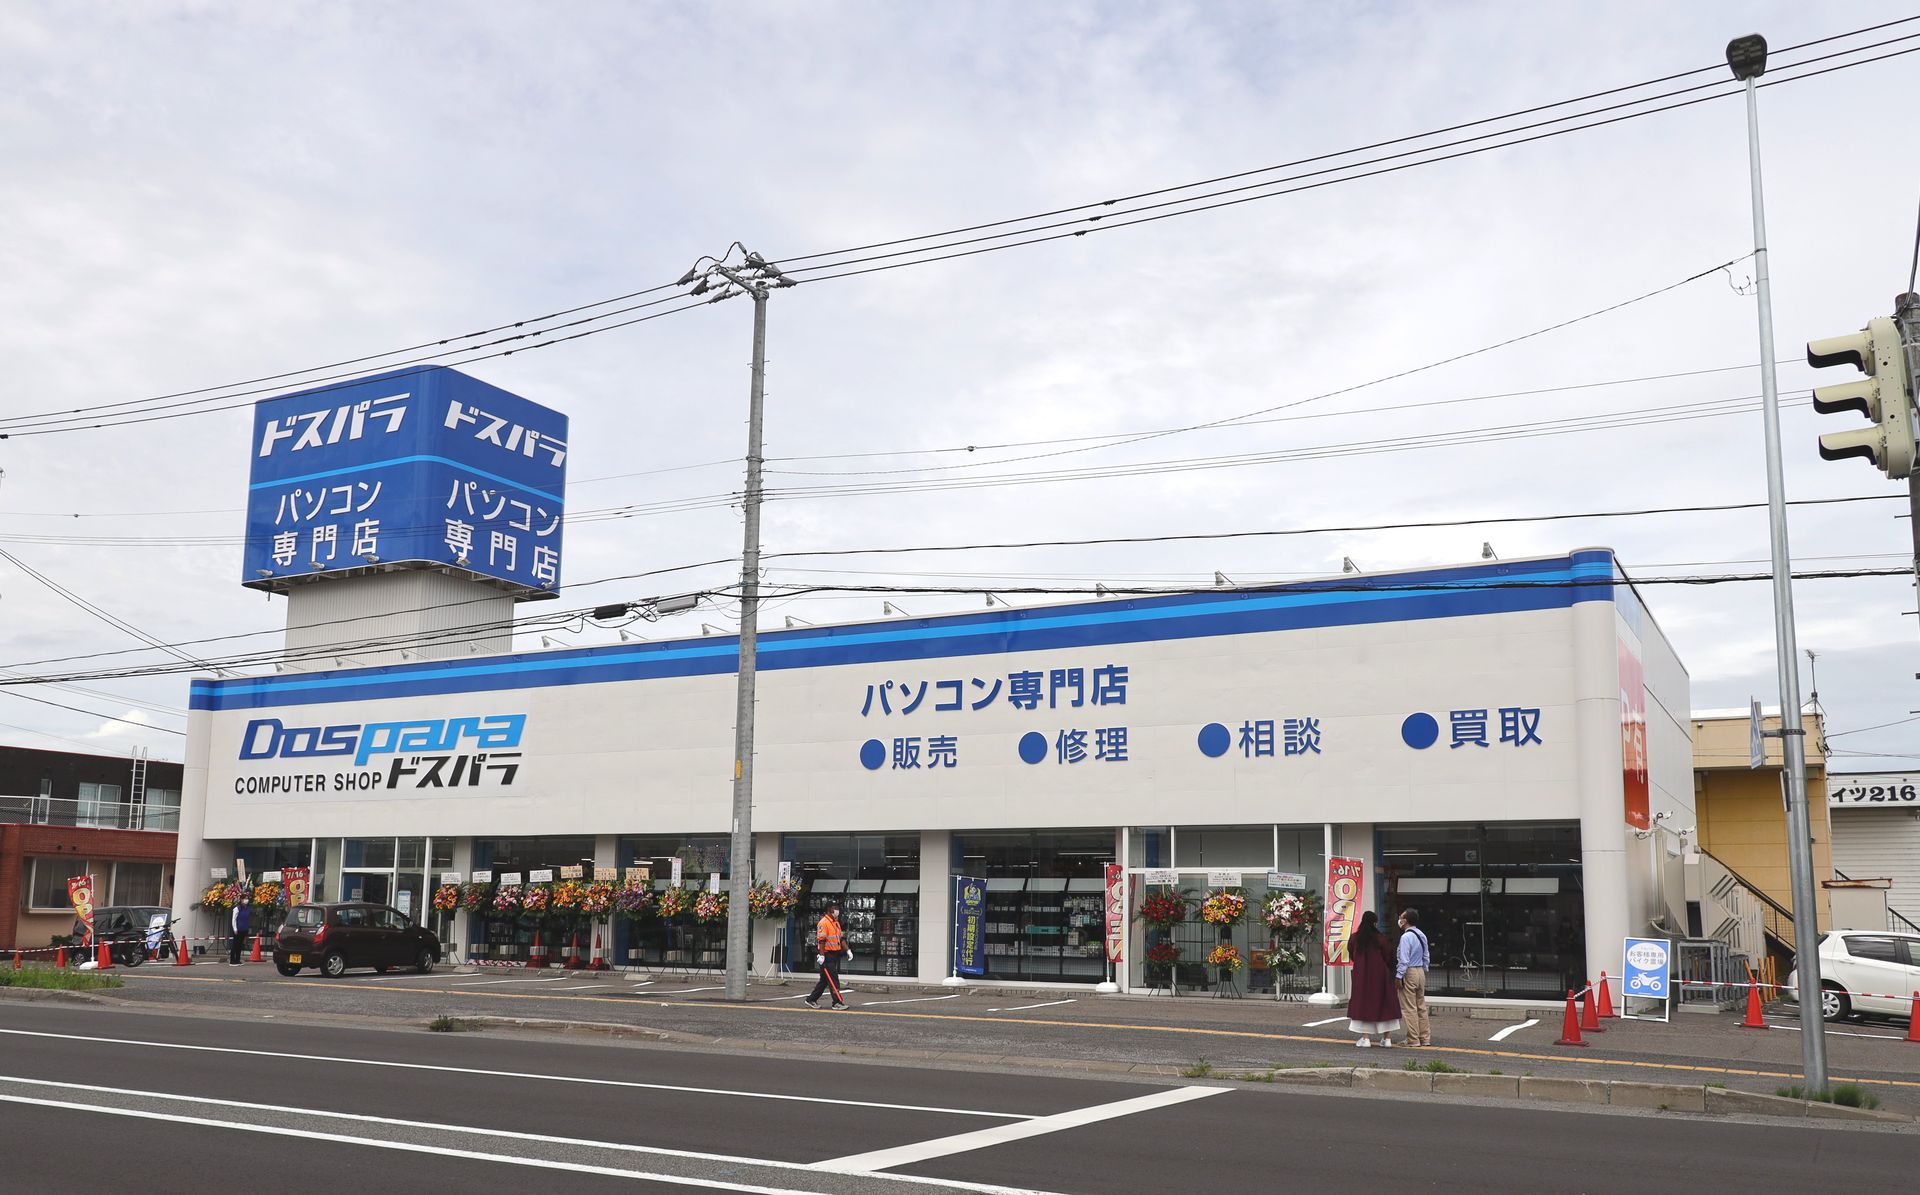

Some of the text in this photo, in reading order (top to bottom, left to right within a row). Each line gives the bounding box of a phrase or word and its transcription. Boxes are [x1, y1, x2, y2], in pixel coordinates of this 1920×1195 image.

[259, 393, 410, 457] ドスパラ
[444, 399, 567, 468] ドスパラ
[274, 481, 383, 526] パソコン
[447, 479, 560, 537] パソコン
[272, 518, 380, 566] 専門店
[444, 518, 559, 584] 専門店
[861, 664, 1129, 717] パソコン専門店
[238, 714, 527, 766] Dospara
[892, 706, 1543, 770] 販売 修理 相談 買取
[234, 771, 382, 795] COMPUTER SHOP
[386, 752, 522, 789] ドスパラ
[1829, 785, 1916, 803] イツ216
[286, 870, 304, 880] 7/16
